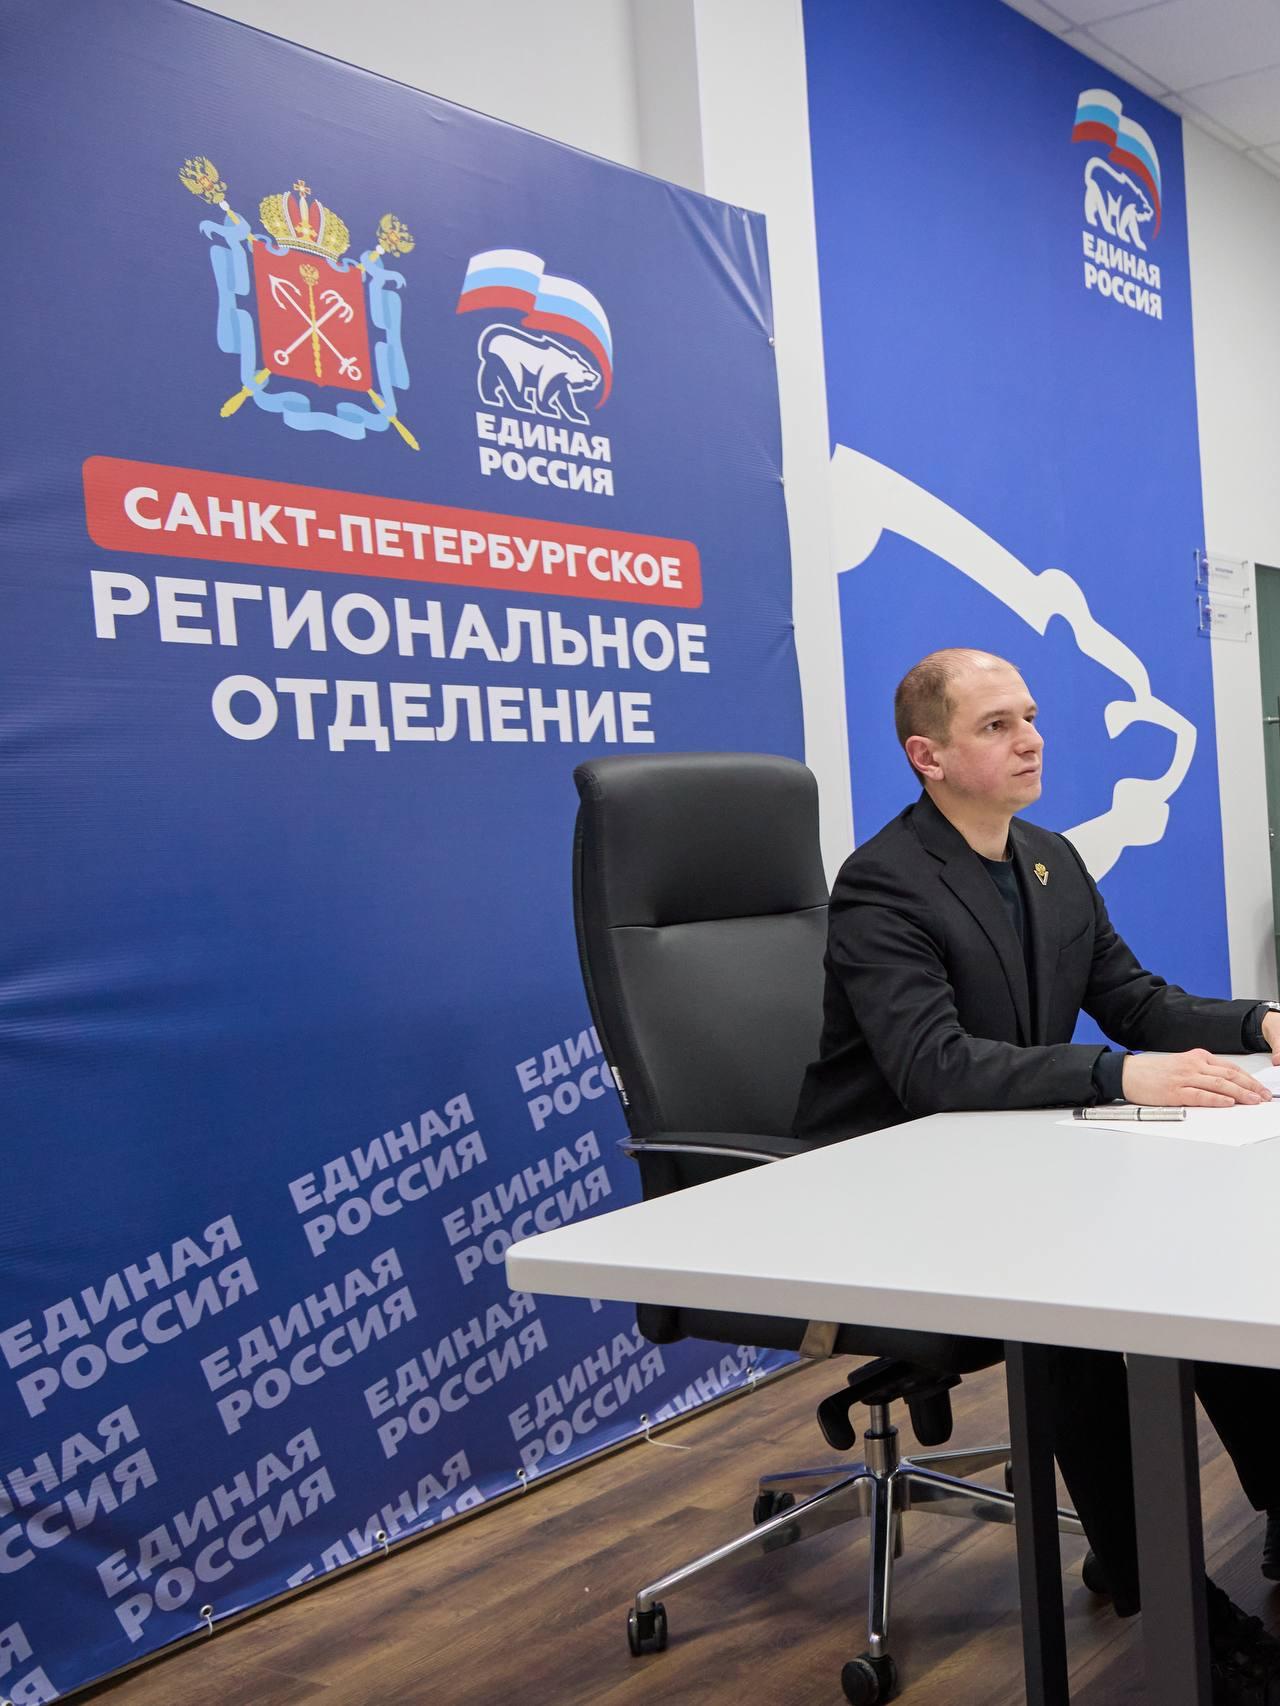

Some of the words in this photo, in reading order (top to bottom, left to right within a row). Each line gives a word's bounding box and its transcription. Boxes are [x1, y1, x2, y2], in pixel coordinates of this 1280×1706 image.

[1083, 231, 1161, 290] ЕДИНАЯ
[1084, 262, 1162, 320] РОССИЯ
[476, 412, 611, 462] ЕДИНАЯ
[479, 446, 614, 496] РОССИЯ
[123, 487, 683, 589] САНКТ-ПЕТЕРБУРГСКОЕ
[90, 570, 710, 673] РЕГИОНАЛЬНОЕ
[211, 674, 655, 752] ОТДЕЛЕНИЕ
[515, 1026, 603, 1093] ЕДИ
[527, 1060, 617, 1132] РОС
[288, 1092, 475, 1214] ЕДИНАЯ
[303, 1130, 488, 1257] РОССИЯ
[441, 1130, 601, 1246] ЕДИНАЯ
[454, 1165, 613, 1286] РОССИЯ
[0, 1214, 243, 1369] ЕДИНАЯ
[15, 1256, 260, 1419] РОССИЯ
[200, 1247, 404, 1392] ЕДИНАЯ
[216, 1286, 418, 1436] РОССИЯ
[363, 1291, 537, 1419] ЕДИНАЯ
[376, 1318, 549, 1460] РОССИЯ
[519, 1346, 666, 1476] РОССИЯ
[0, 1404, 141, 1518] НАЯ
[0, 1447, 158, 1574] ССИЯ
[96, 1427, 322, 1599] ЕДИНАЯ
[114, 1466, 337, 1643] РОССИЯ
